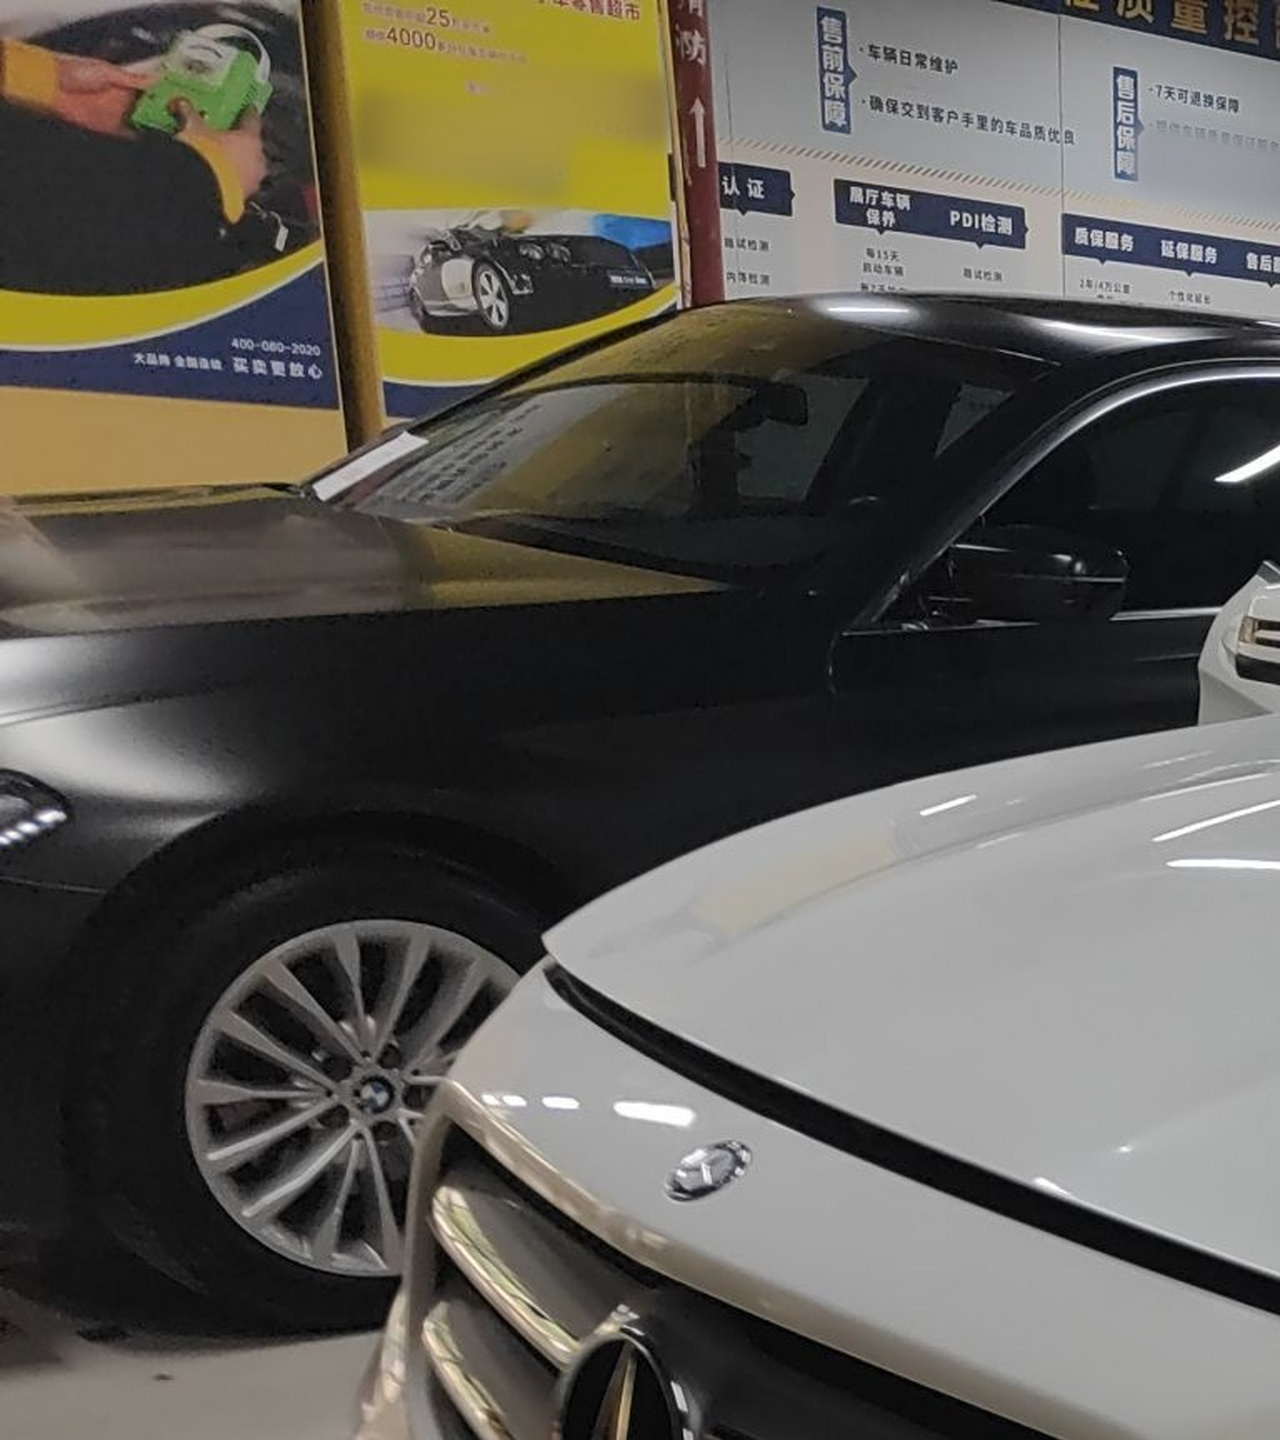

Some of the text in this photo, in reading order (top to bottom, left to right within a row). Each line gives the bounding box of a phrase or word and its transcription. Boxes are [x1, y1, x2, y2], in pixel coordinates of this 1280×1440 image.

[820, 16, 848, 128] 售前保障
[868, 44, 958, 74] 车辆日常维护
[869, 95, 1075, 145] 确保交到客户手里的车品质优良
[1116, 74, 1137, 176] 售后保障
[721, 175, 765, 200] 认证
[950, 210, 1013, 235] PDI检测
[1074, 227, 1134, 253] 质保服务
[1160, 240, 1218, 265] 延保服务
